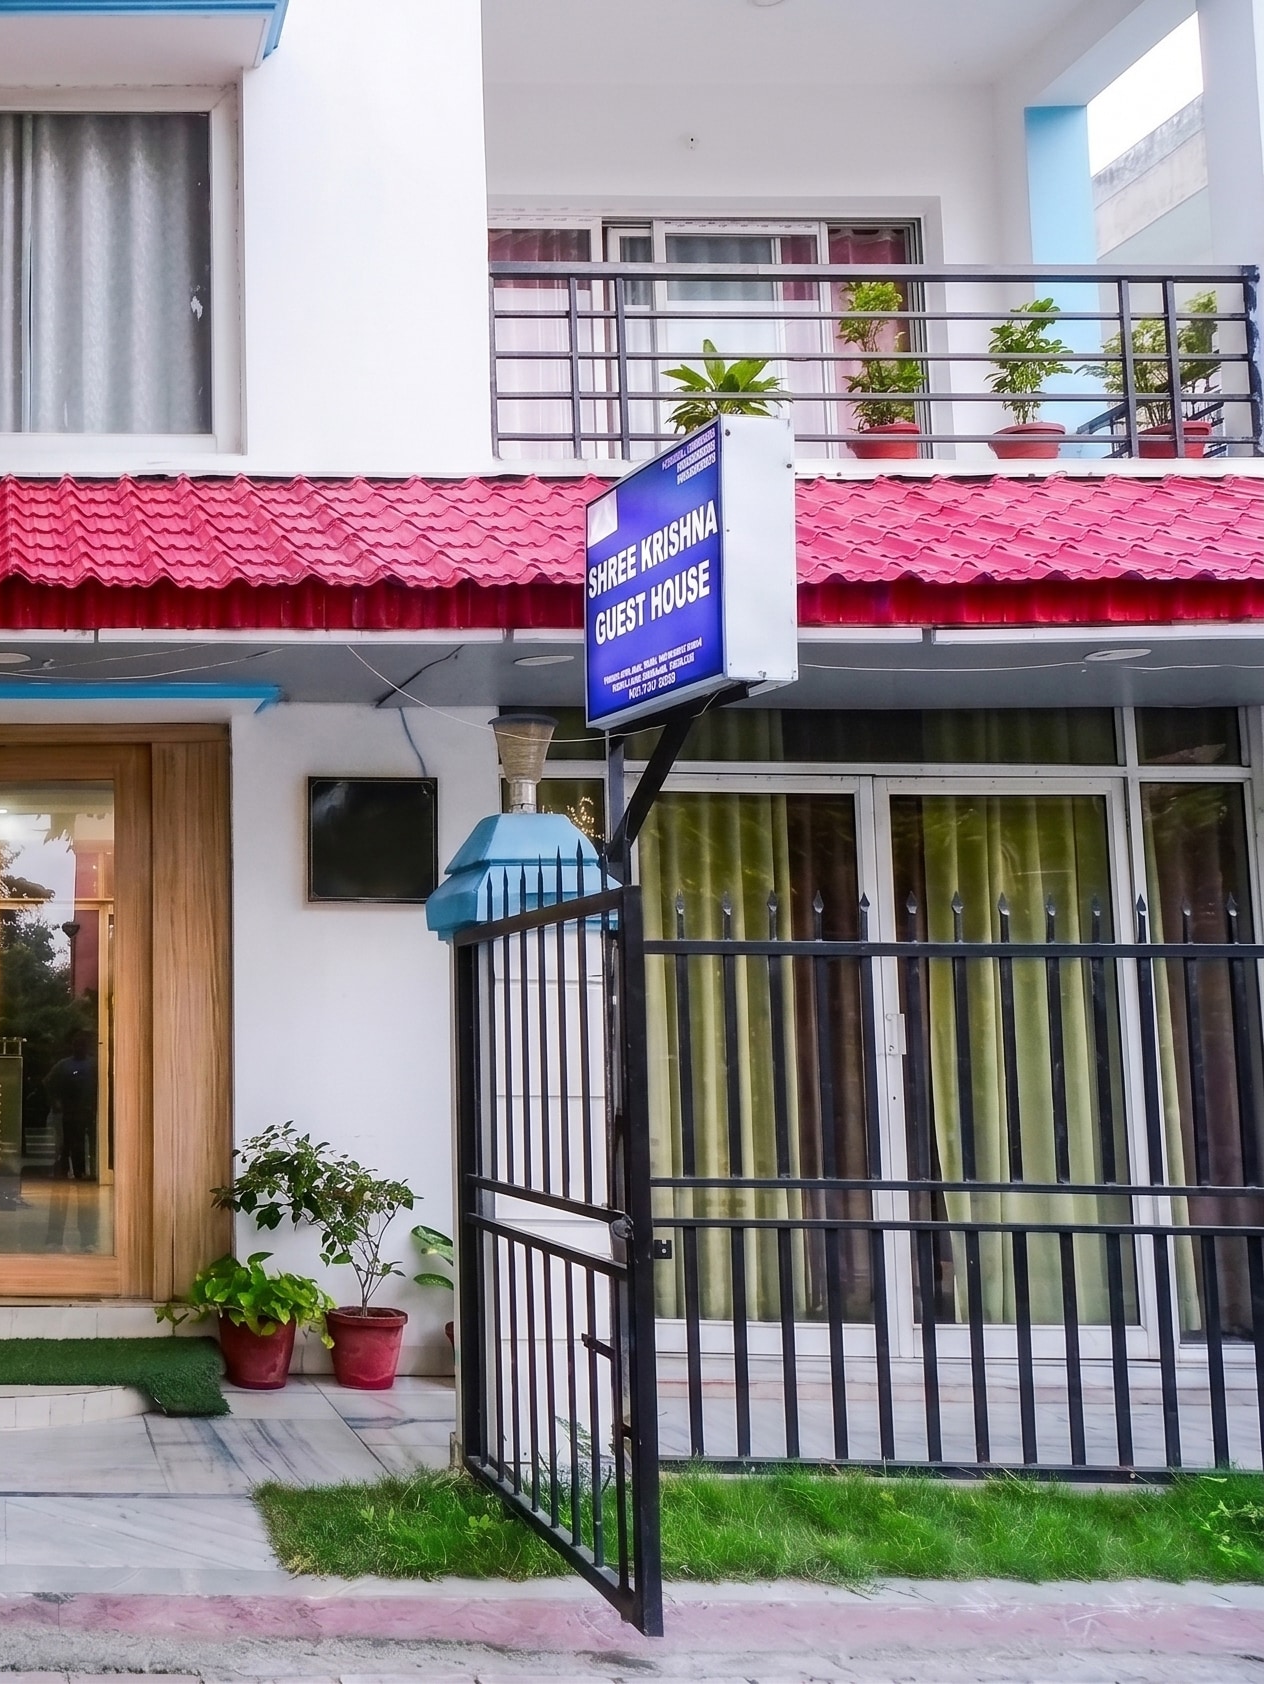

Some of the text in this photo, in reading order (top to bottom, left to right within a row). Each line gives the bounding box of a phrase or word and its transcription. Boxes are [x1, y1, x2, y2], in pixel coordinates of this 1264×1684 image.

[588, 499, 718, 599] SHREE KRISHNA
[595, 559, 711, 646] GUEST HOUSE
